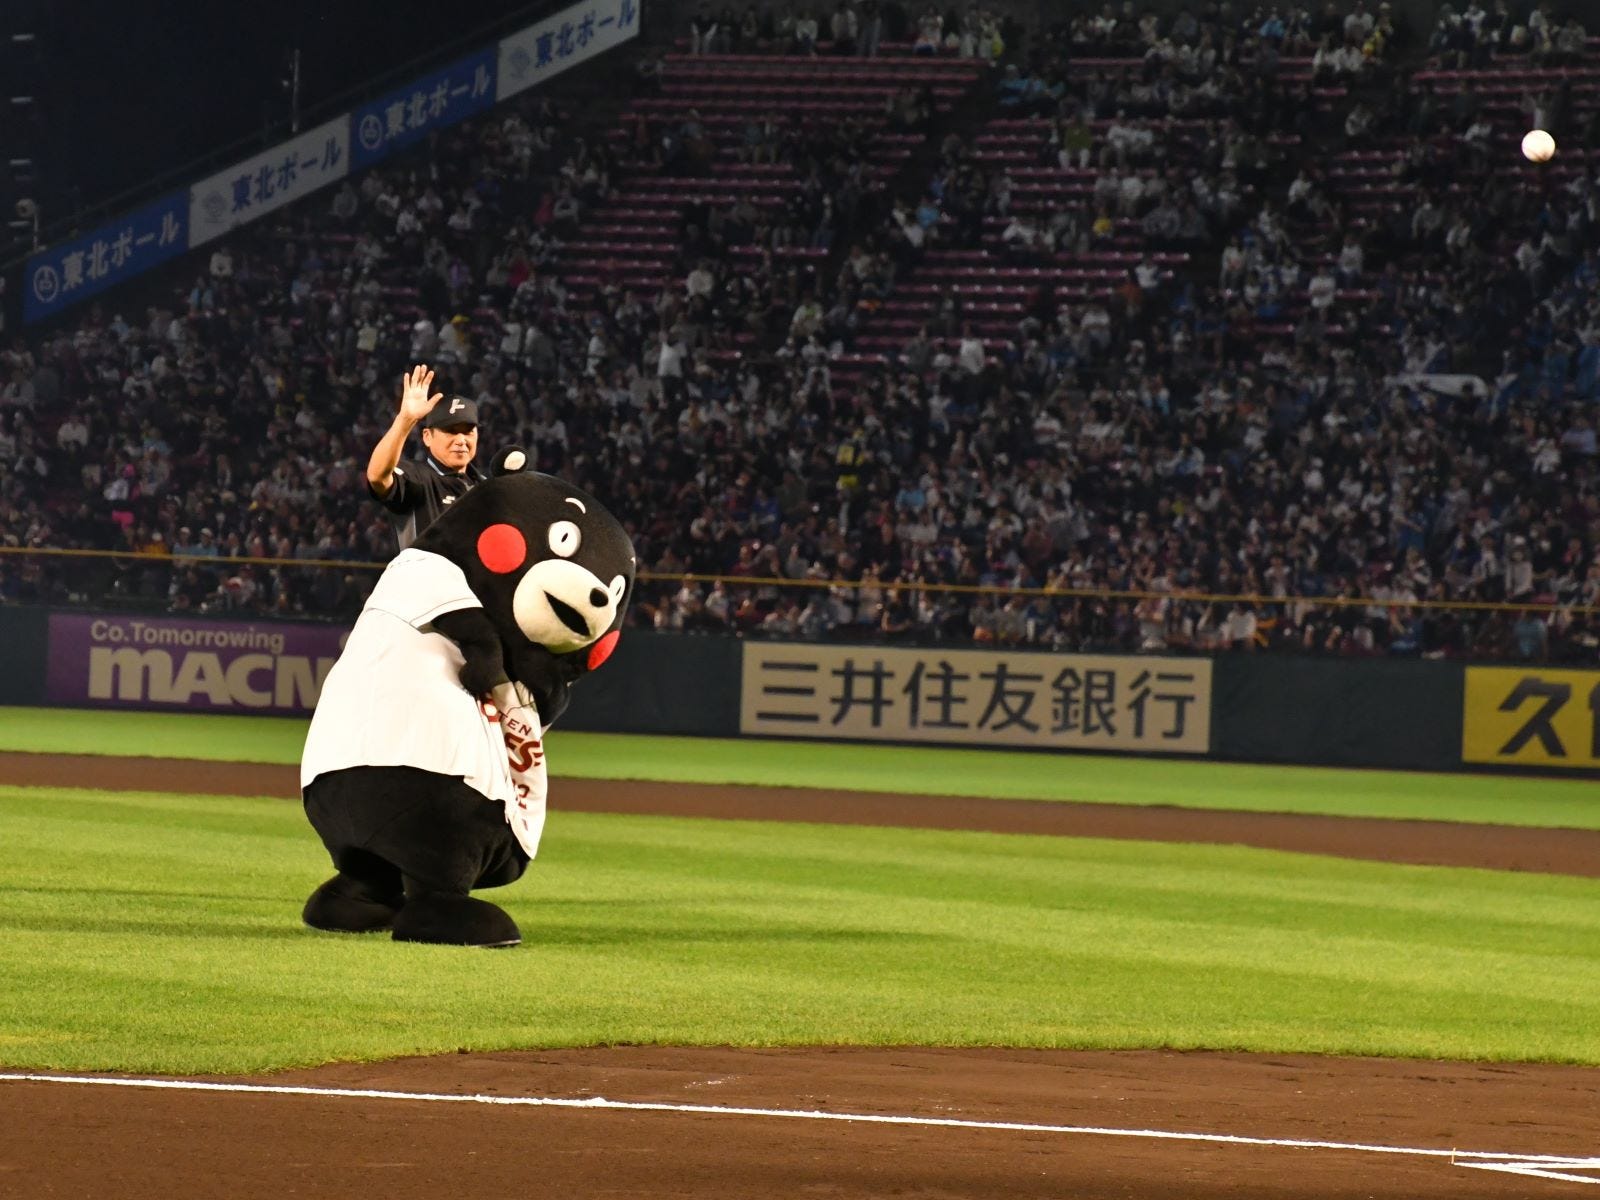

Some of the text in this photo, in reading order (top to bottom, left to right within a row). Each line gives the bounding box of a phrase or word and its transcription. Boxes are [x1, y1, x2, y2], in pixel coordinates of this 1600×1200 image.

[535, 0, 635, 68] 東北ボール
[384, 64, 491, 140] 東北ボール
[231, 136, 341, 213] 東北ボール
[61, 211, 180, 292] 東北ボール
[756, 659, 1195, 739] 三井住友銀行
[1498, 677, 1600, 758] 久
